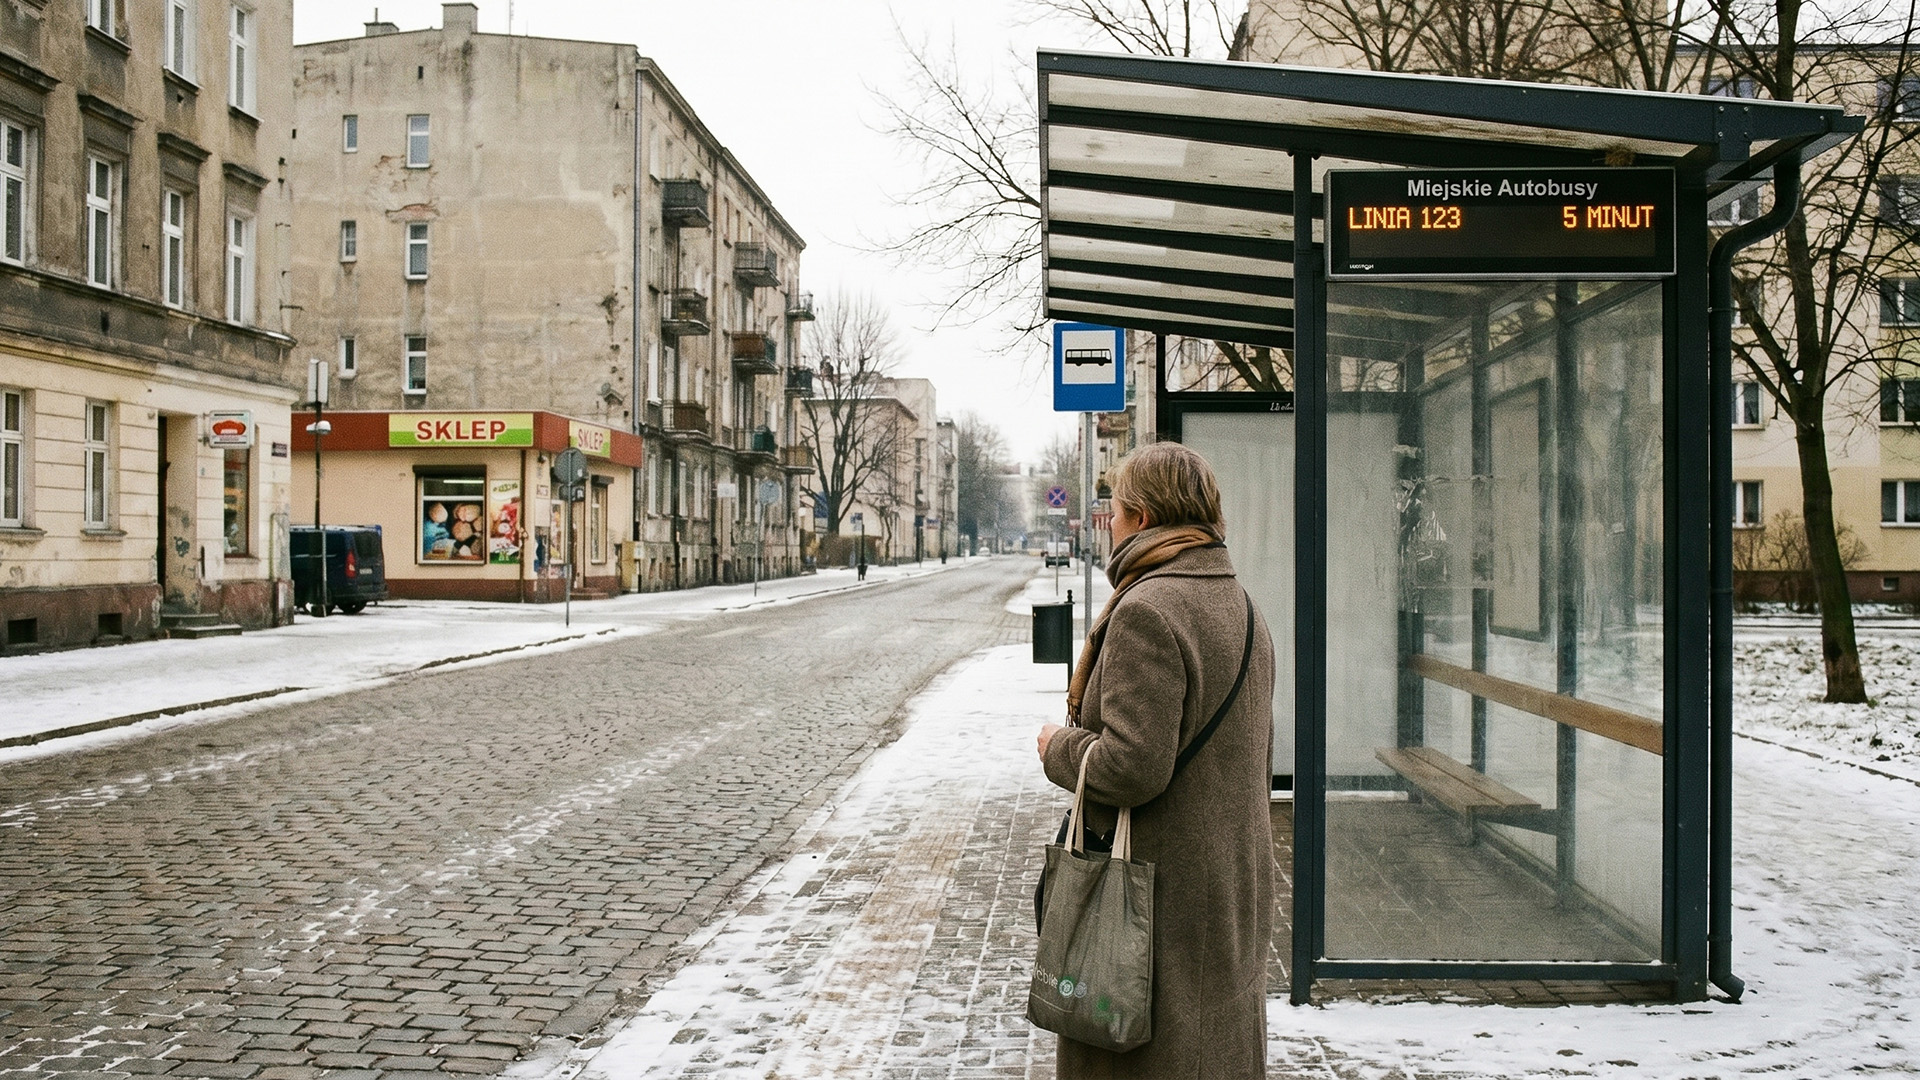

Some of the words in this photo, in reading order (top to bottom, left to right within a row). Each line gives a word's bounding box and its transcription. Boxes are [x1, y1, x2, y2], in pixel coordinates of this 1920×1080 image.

[1407, 179, 1492, 200] Miejskie
[1497, 178, 1598, 201] Autobusy
[1348, 206, 1411, 230] LINIA
[1421, 206, 1462, 230] 123
[1563, 205, 1578, 229] 5
[1586, 205, 1655, 229] MINUT
[416, 420, 507, 440] SKLEP
[578, 428, 603, 451] SKLEP
